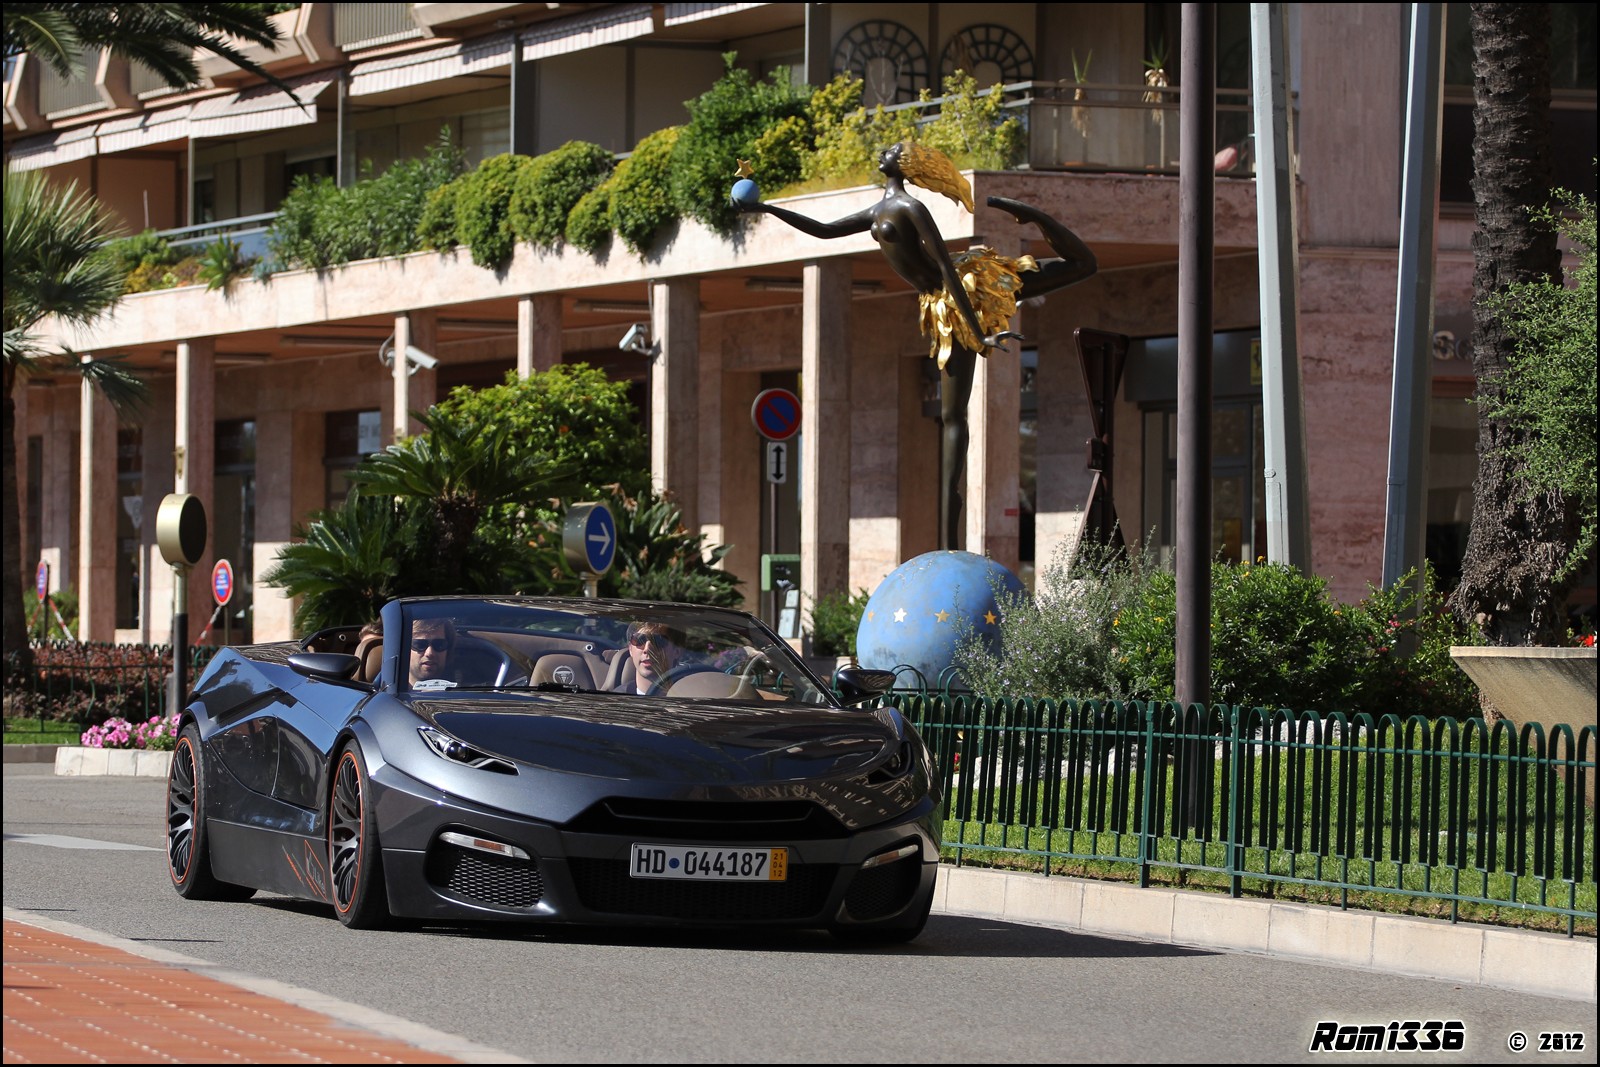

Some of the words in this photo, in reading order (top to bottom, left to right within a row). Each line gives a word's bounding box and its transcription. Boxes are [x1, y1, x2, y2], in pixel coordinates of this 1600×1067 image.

[773, 852, 784, 860] 21
[636, 848, 667, 874] HD
[683, 850, 768, 877] 044187
[772, 861, 783, 869] 04
[773, 869, 783, 877] 12
